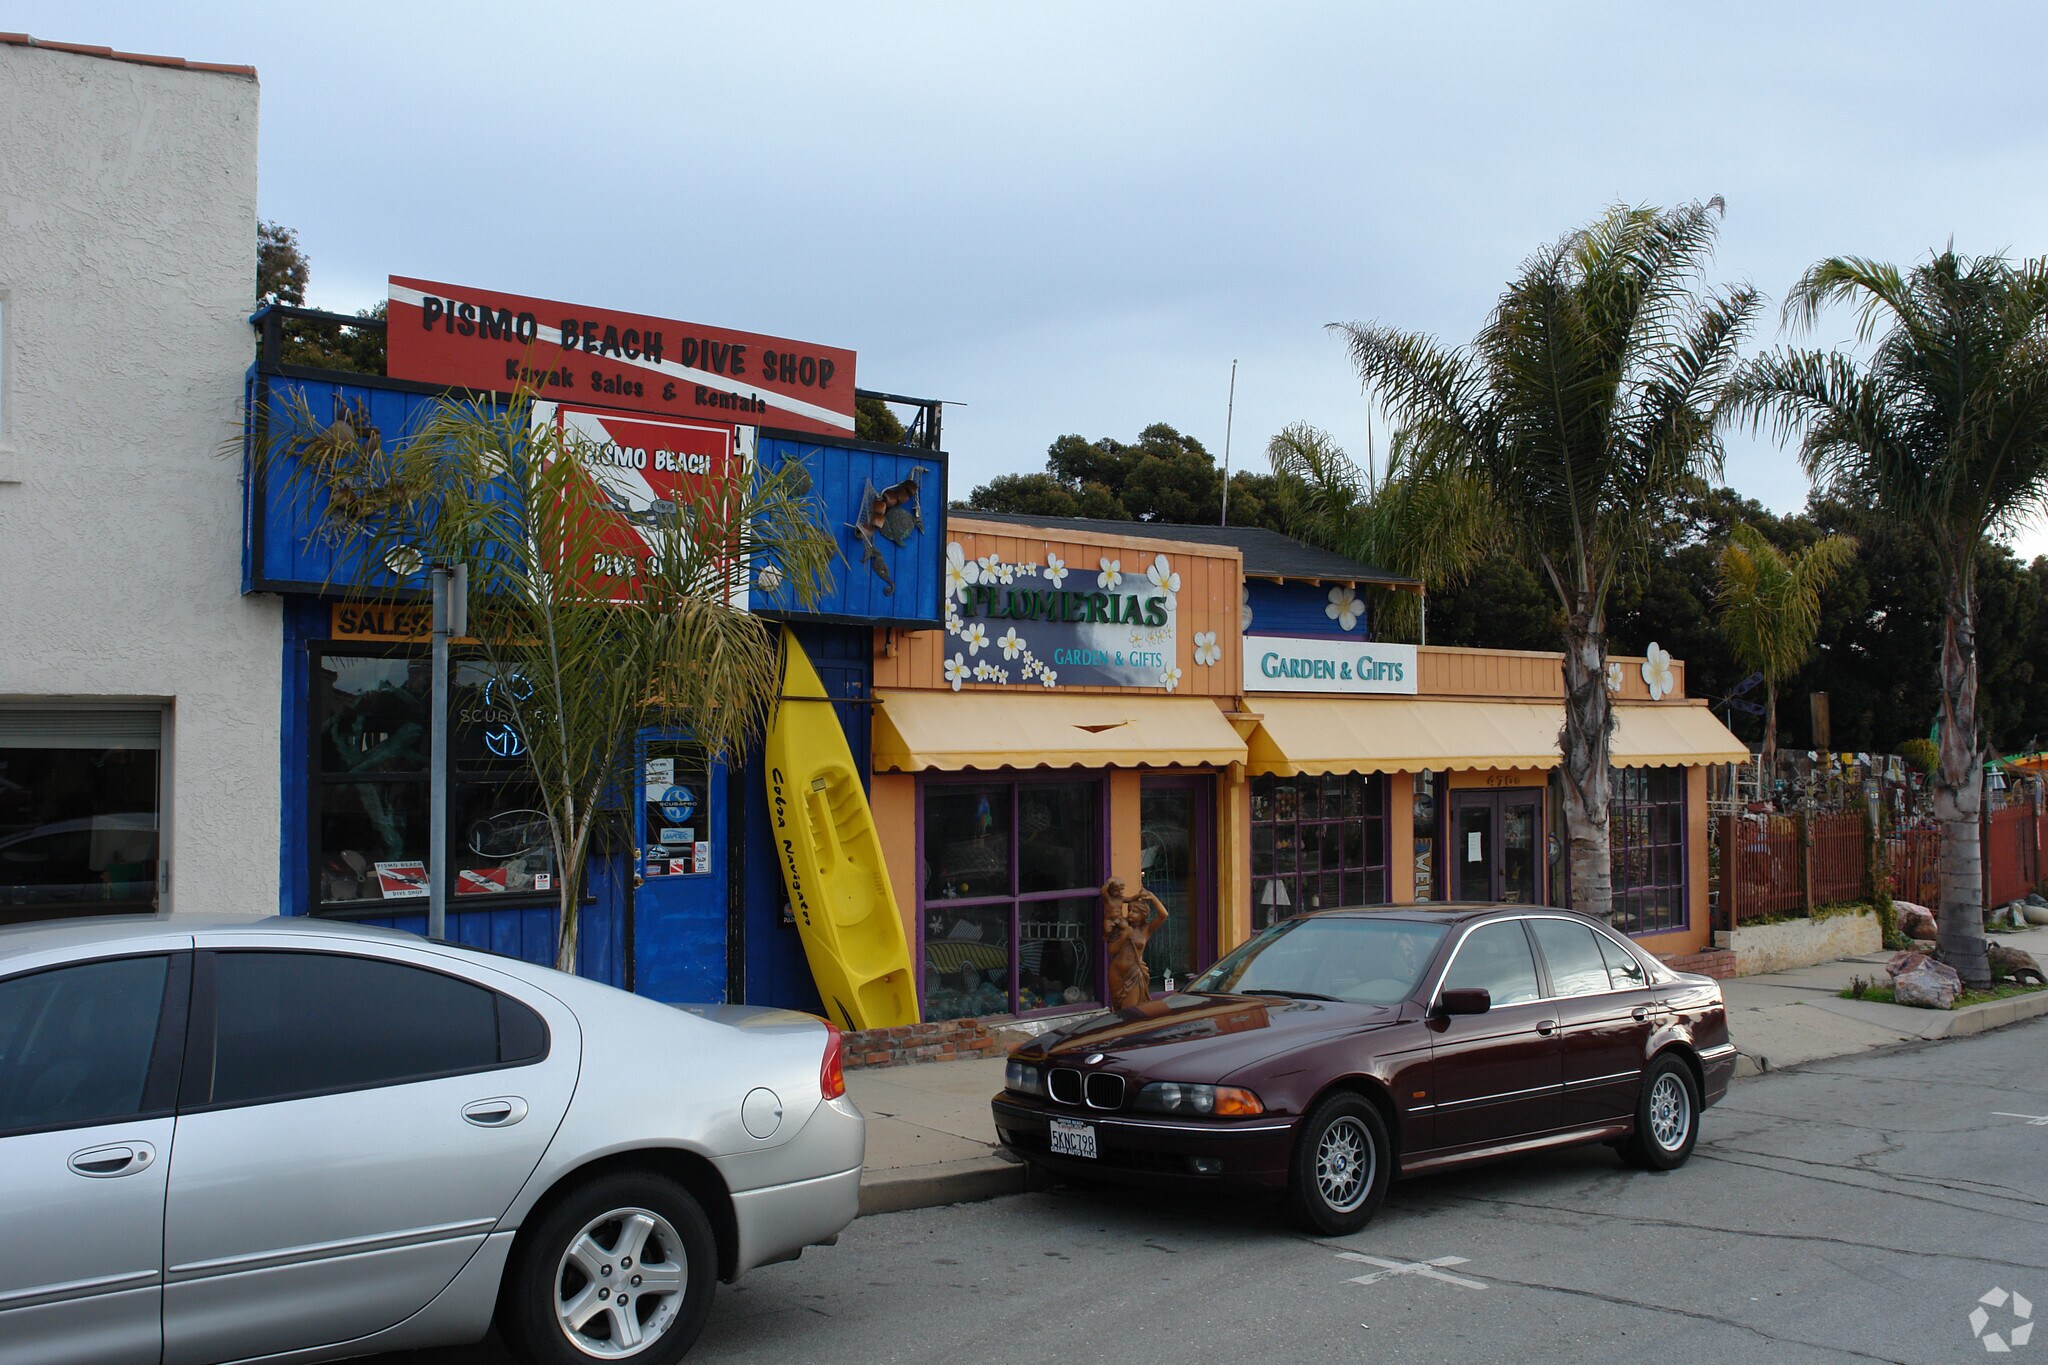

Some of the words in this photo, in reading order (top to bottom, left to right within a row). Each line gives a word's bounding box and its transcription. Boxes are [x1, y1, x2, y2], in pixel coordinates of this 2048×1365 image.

[422, 296, 537, 344] PISMO
[561, 319, 664, 364] BEACH
[682, 336, 746, 376] DIVE
[762, 350, 835, 389] SHOP
[506, 358, 574, 388] Kayak
[591, 372, 644, 398] Sales
[663, 382, 677, 400] &
[695, 385, 767, 415] Rentals
[580, 441, 647, 470] PISMO
[654, 450, 711, 475] BEACH
[338, 610, 428, 637] SALES
[961, 586, 1169, 627] PLUMERIAS
[1054, 648, 1109, 667] GARDEN
[1116, 651, 1124, 666] &
[1130, 651, 1163, 668] GIFTS
[1340, 661, 1353, 680] &
[783, 840, 811, 927] Navigator
[1053, 1130, 1094, 1152] 5KNC798
